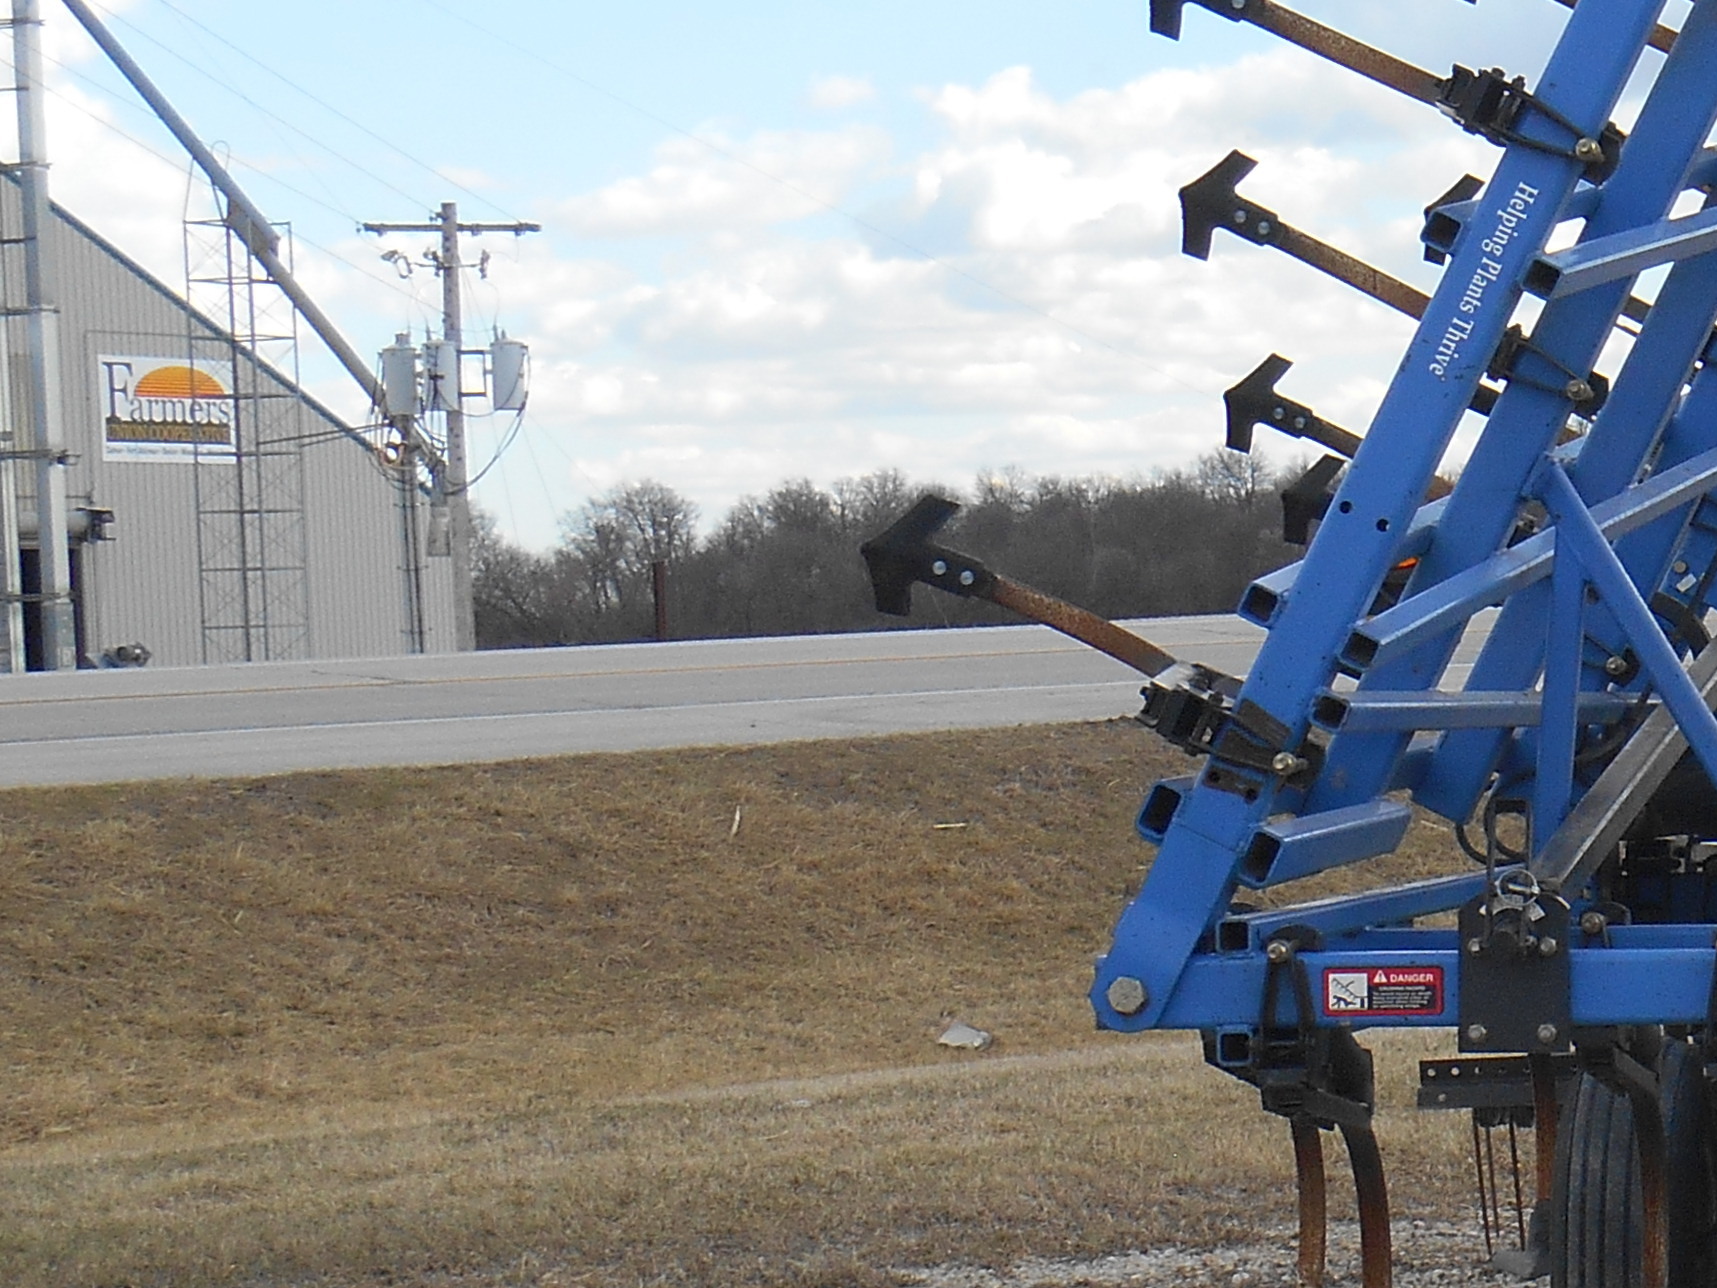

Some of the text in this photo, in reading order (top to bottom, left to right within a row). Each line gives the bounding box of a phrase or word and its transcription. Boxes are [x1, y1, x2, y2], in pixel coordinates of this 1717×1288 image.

[1429, 181, 1539, 376] Helping Plants Thrive
[102, 362, 231, 423] Farmers
[1389, 973, 1434, 983] DANGER
